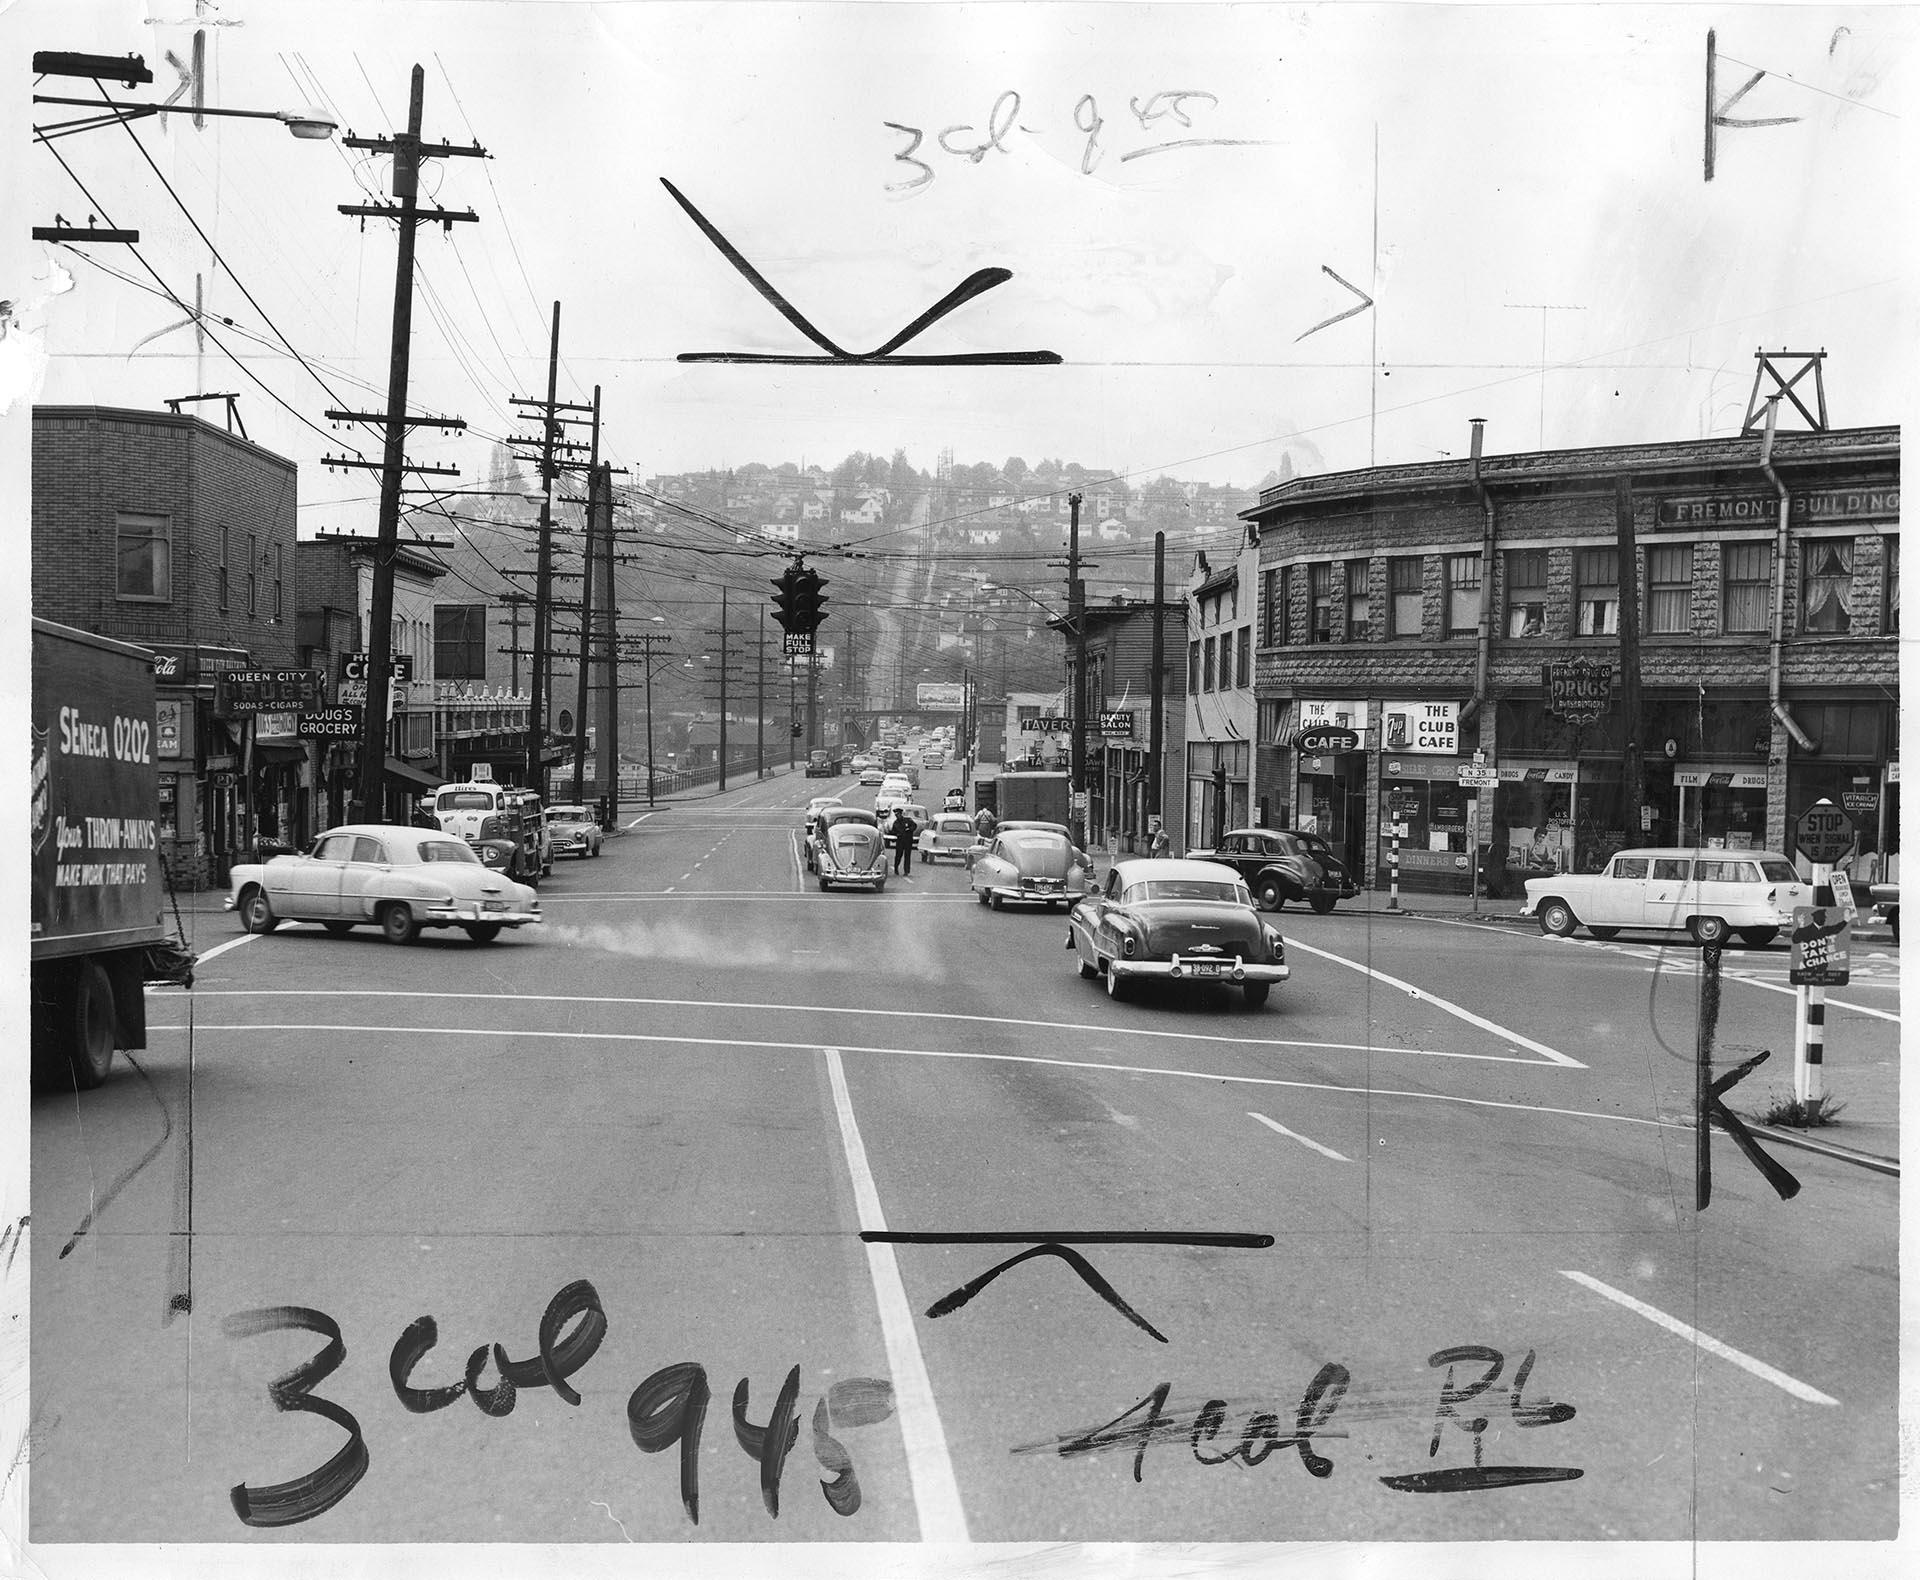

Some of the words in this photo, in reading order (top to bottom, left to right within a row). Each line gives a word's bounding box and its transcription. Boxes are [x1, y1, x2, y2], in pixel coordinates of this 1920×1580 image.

[1677, 500, 1778, 520] FREMONT
[1795, 494, 1899, 514] BUILDING
[228, 672, 270, 682] QUEEN
[277, 672, 307, 681] CITY
[1553, 680, 1609, 697] DRUGS
[1310, 704, 1325, 715] THE
[1425, 705, 1448, 717] THE
[300, 722, 358, 735] GROCERY
[1419, 721, 1455, 733] CLUB
[113, 714, 151, 764] 0202
[1304, 736, 1353, 749] CAFE
[1418, 737, 1454, 749] CAFE
[1500, 770, 1519, 778] DRUGS
[1554, 772, 1575, 780] CANDY
[1680, 775, 1698, 783] FILM
[1742, 776, 1766, 785] DRUGS
[1461, 779, 1491, 787] FREMONT
[1807, 813, 1843, 832] STOP
[85, 816, 156, 850] THROW-AWAYS
[1799, 833, 1821, 845] WHEN
[1824, 833, 1852, 845] SIGNAL
[1810, 846, 1820, 857] IS
[1824, 846, 1840, 857] OFF
[1405, 854, 1449, 867] DINNERS
[56, 863, 81, 887] MAKE
[81, 863, 105, 886] WORK
[106, 863, 124, 885] THAT
[124, 863, 147, 884] PAYS
[1801, 935, 1838, 951] DON'T
[1802, 944, 1836, 959] TAKE
[1799, 960, 1807, 970] A
[1806, 951, 1848, 968] CHANCE
[221, 1305, 370, 1527] 3
